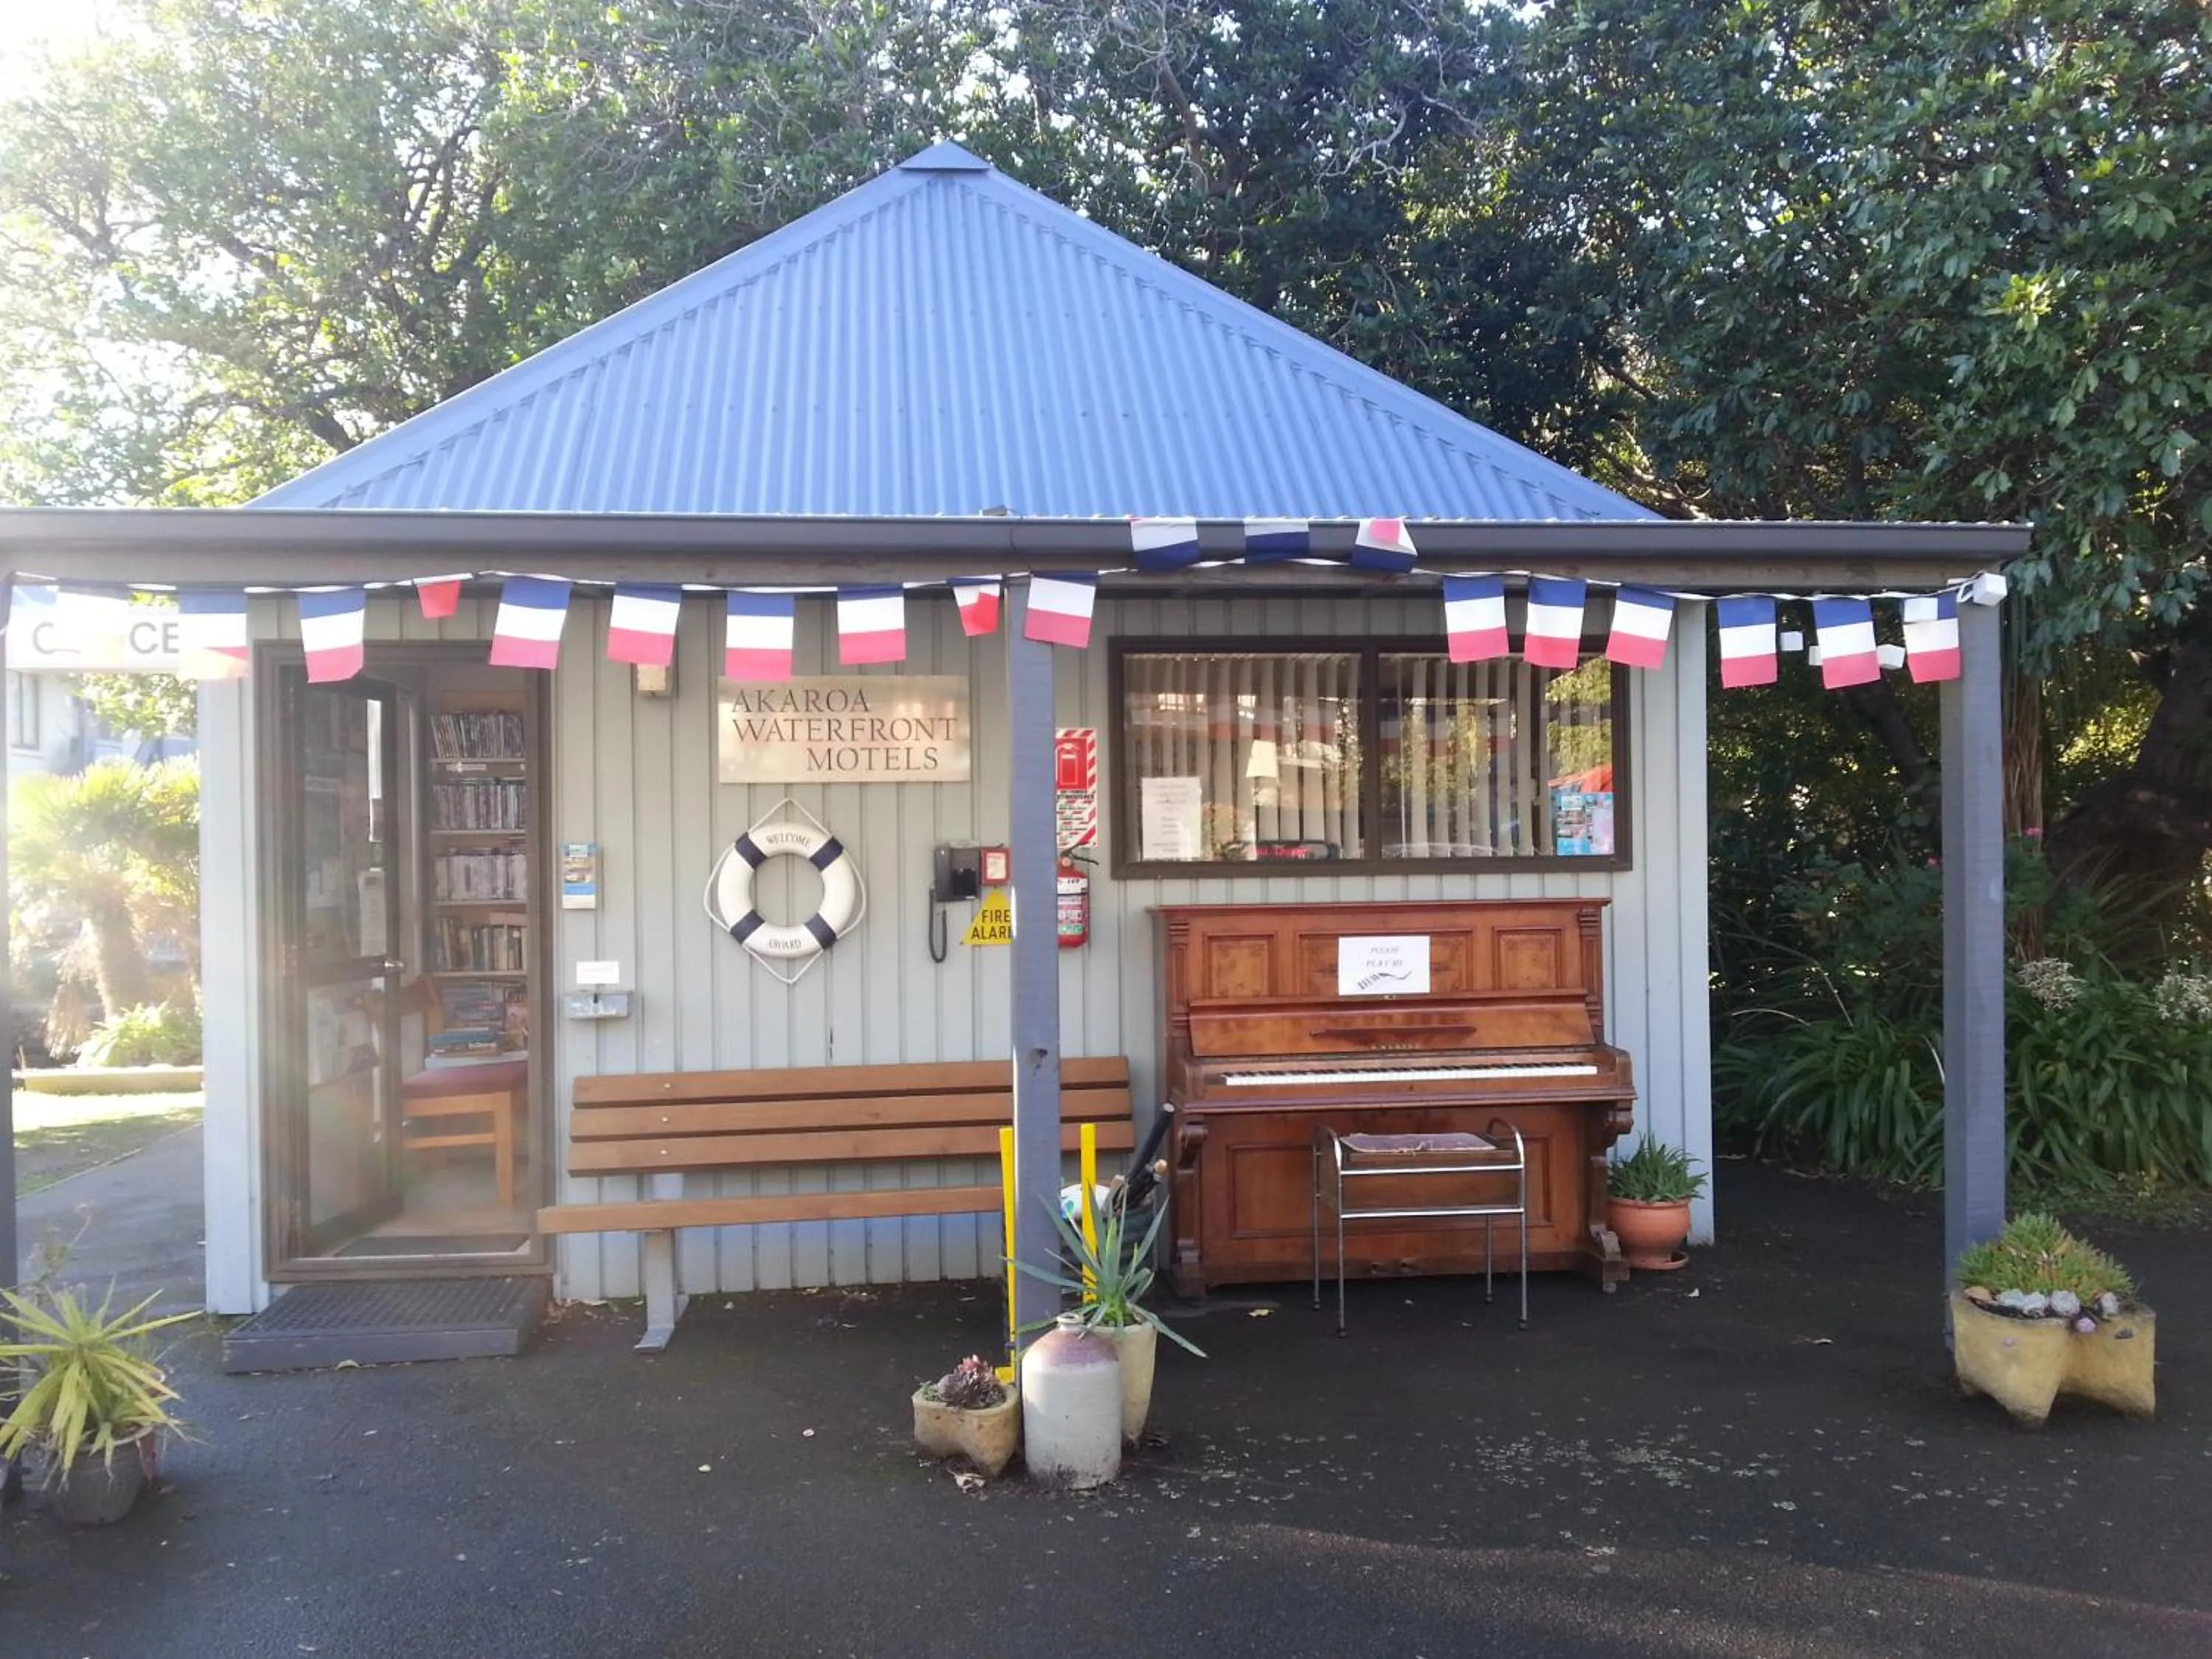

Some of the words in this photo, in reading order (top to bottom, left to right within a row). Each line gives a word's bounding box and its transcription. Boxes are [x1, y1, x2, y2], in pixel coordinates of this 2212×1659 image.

[731, 689, 872, 713] AKAROA
[732, 717, 958, 742] WATERFRONT
[806, 747, 939, 771] MOTELS
[766, 832, 810, 847] WELCOME
[981, 909, 1011, 923] FIRE
